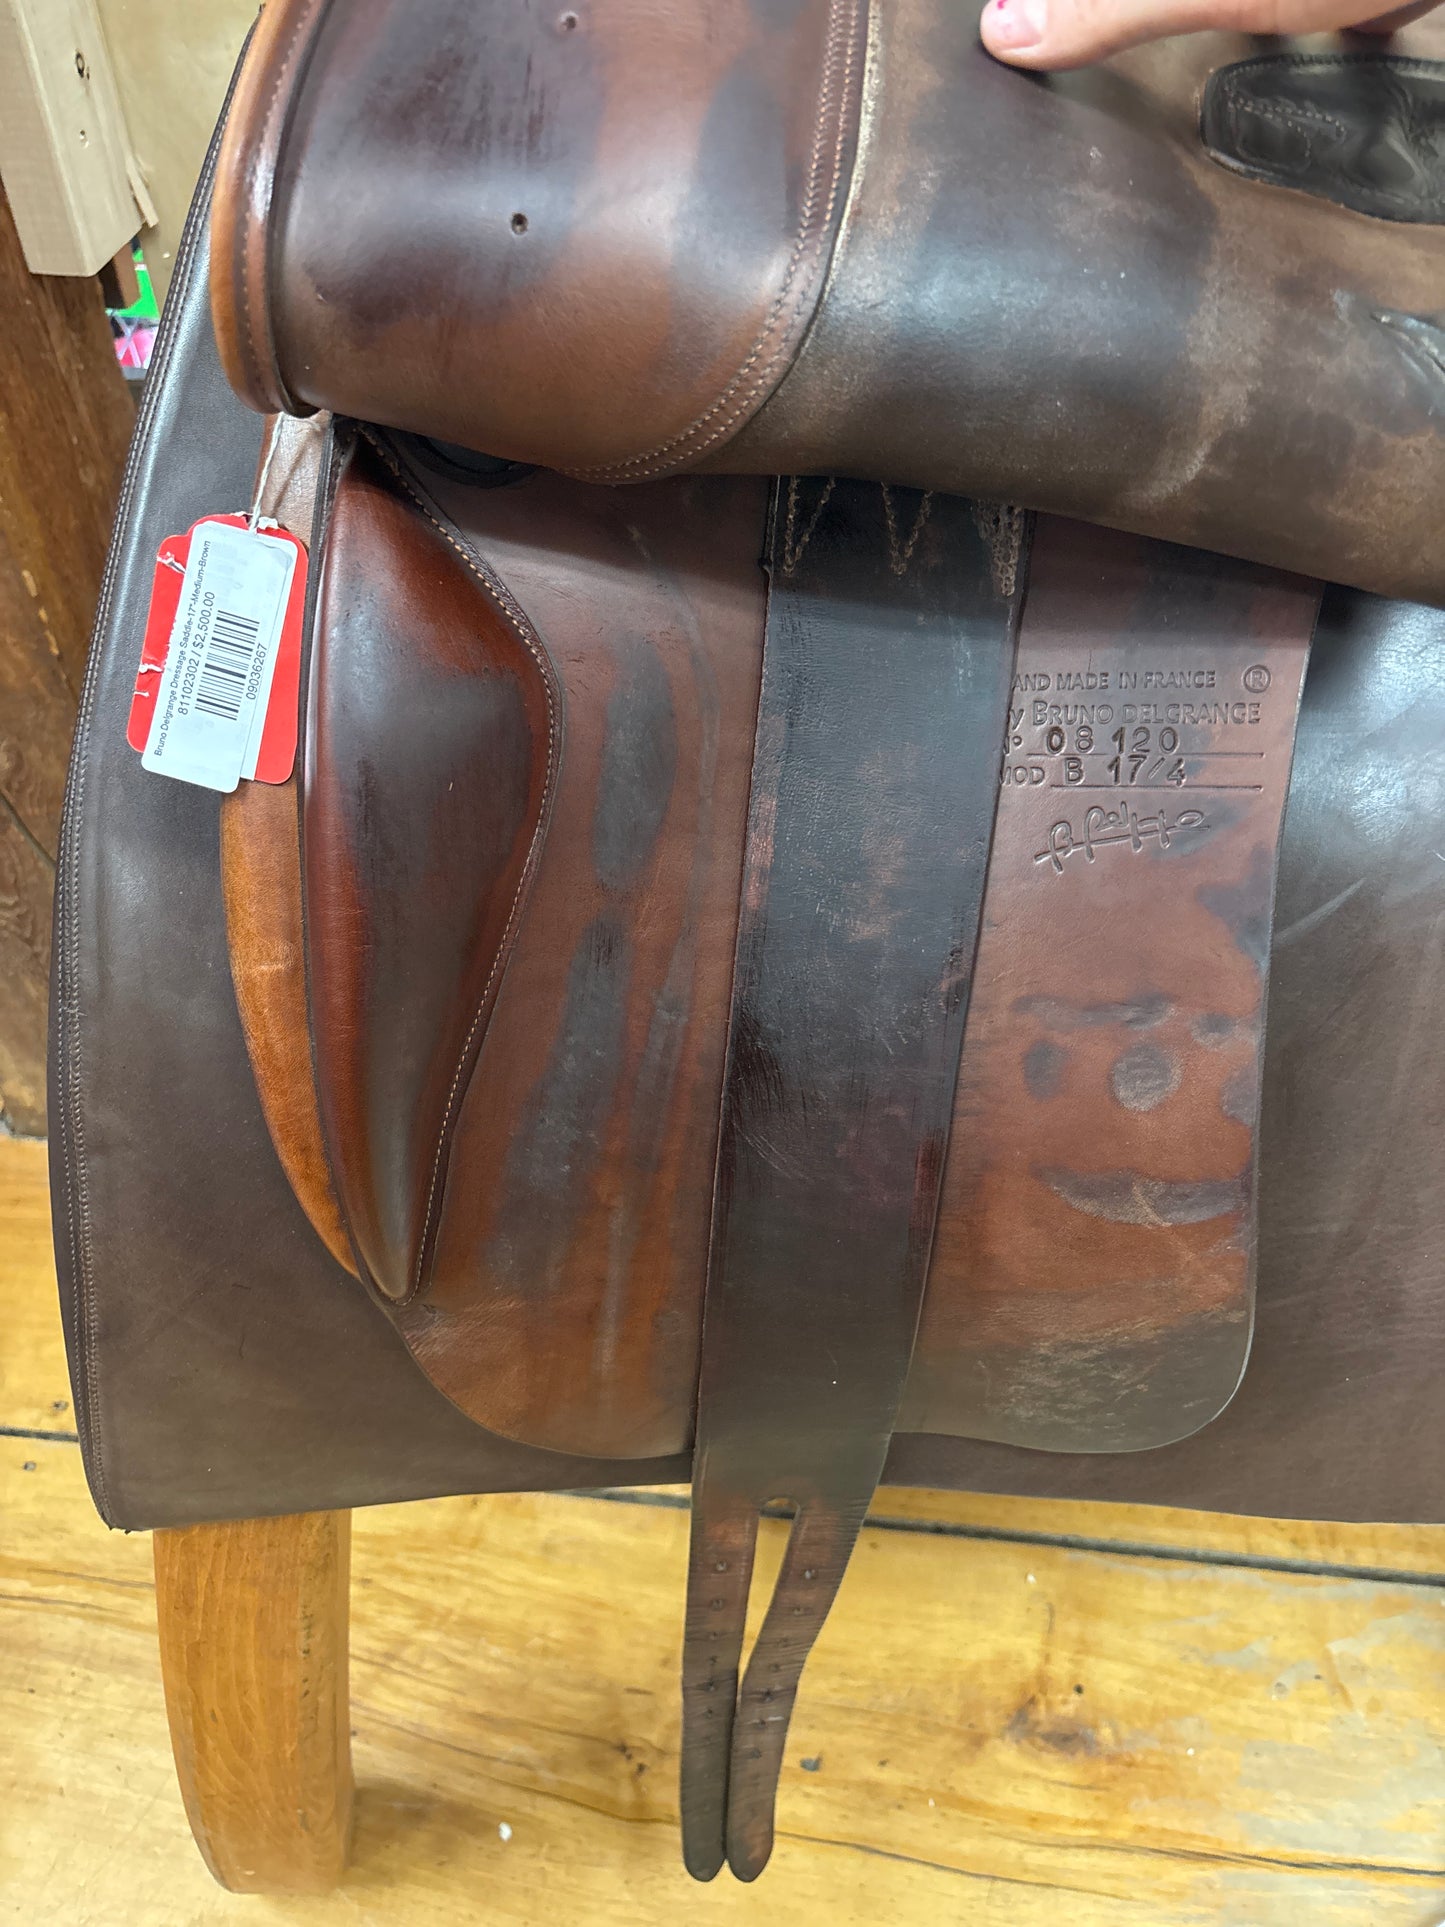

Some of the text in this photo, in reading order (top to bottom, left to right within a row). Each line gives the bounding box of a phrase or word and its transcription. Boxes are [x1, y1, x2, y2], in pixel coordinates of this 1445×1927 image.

[170, 650, 187, 689] Dressage
[177, 658, 200, 716] 81102302
[192, 591, 216, 650] $2,500.00
[245, 643, 268, 701] 09036267
[1013, 673, 1051, 692] AND
[1056, 672, 1110, 691] MADE
[1118, 671, 1138, 690] IN
[1145, 670, 1217, 690] FRANCE
[160, 690, 178, 731] Delgrange
[1010, 700, 1262, 731] y BRUNO DELGRANGE
[153, 732, 168, 757] Bruno
[1063, 757, 1085, 786] B
